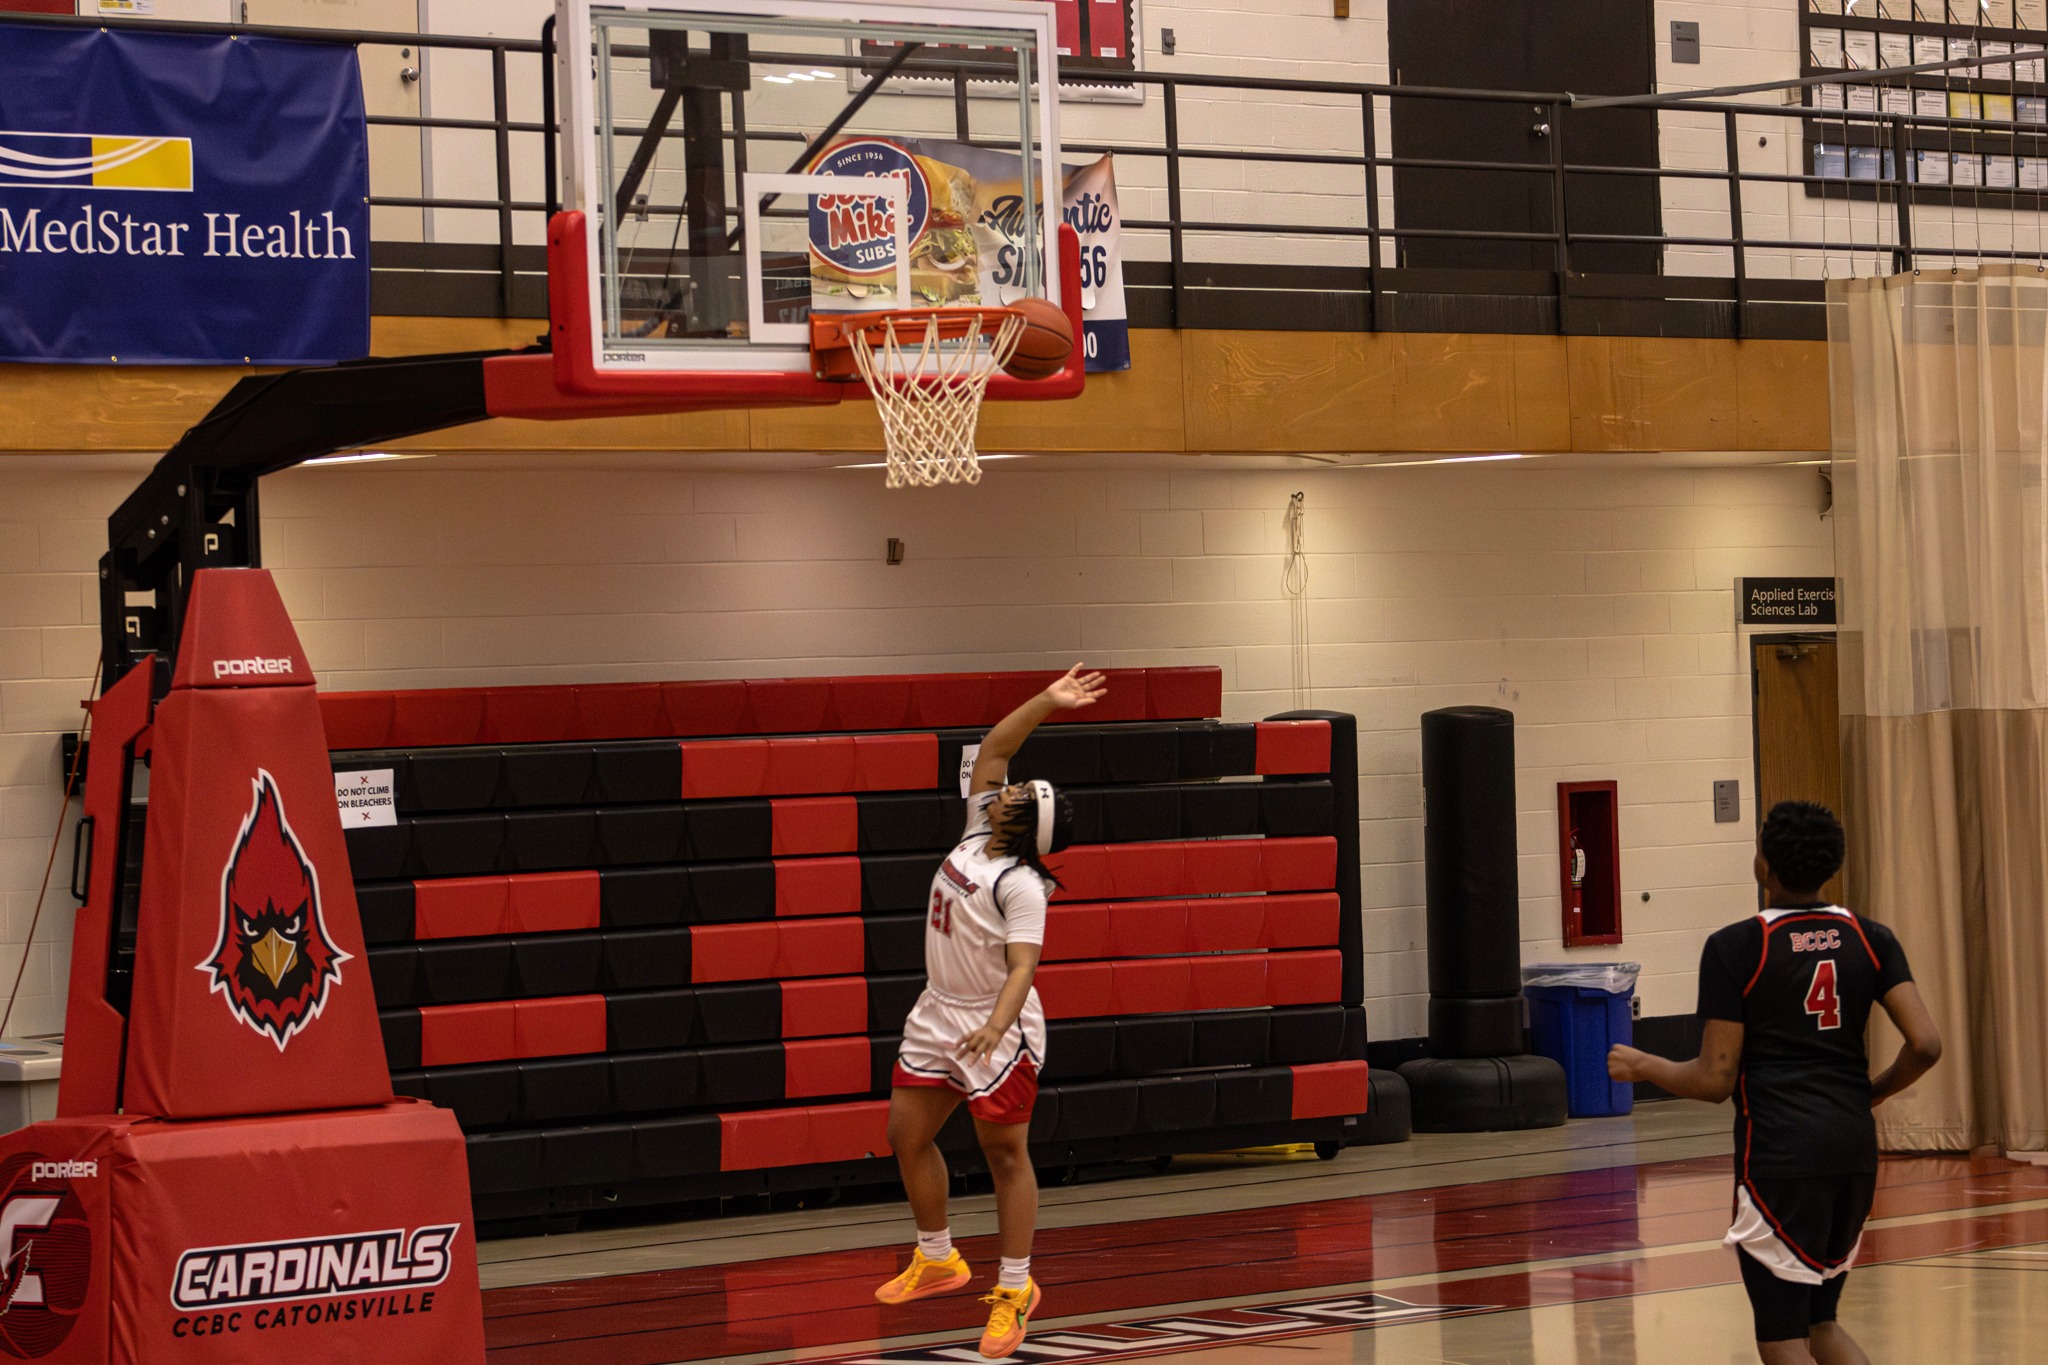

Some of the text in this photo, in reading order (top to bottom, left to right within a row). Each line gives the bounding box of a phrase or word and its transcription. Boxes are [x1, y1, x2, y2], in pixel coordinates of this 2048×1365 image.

[837, 153, 862, 168] SINCE
[0, 204, 356, 259] MedStar Health
[856, 243, 895, 264] SUBS
[603, 352, 645, 364] porter
[1751, 588, 1835, 604] Applied Exercis
[1751, 603, 1818, 616] Sciences Lab
[213, 656, 293, 679] porter
[962, 760, 971, 768] DO
[961, 771, 971, 779] ON
[337, 785, 389, 797] DO NOT CLIMB
[337, 797, 392, 808] ON BLEACHERS
[1789, 929, 1841, 952] BCCC
[1803, 959, 1841, 1031] 4
[31, 1158, 98, 1182] porter
[171, 1224, 460, 1311] CARDINALS
[172, 1291, 435, 1338] CCBC CATONSVILLE
